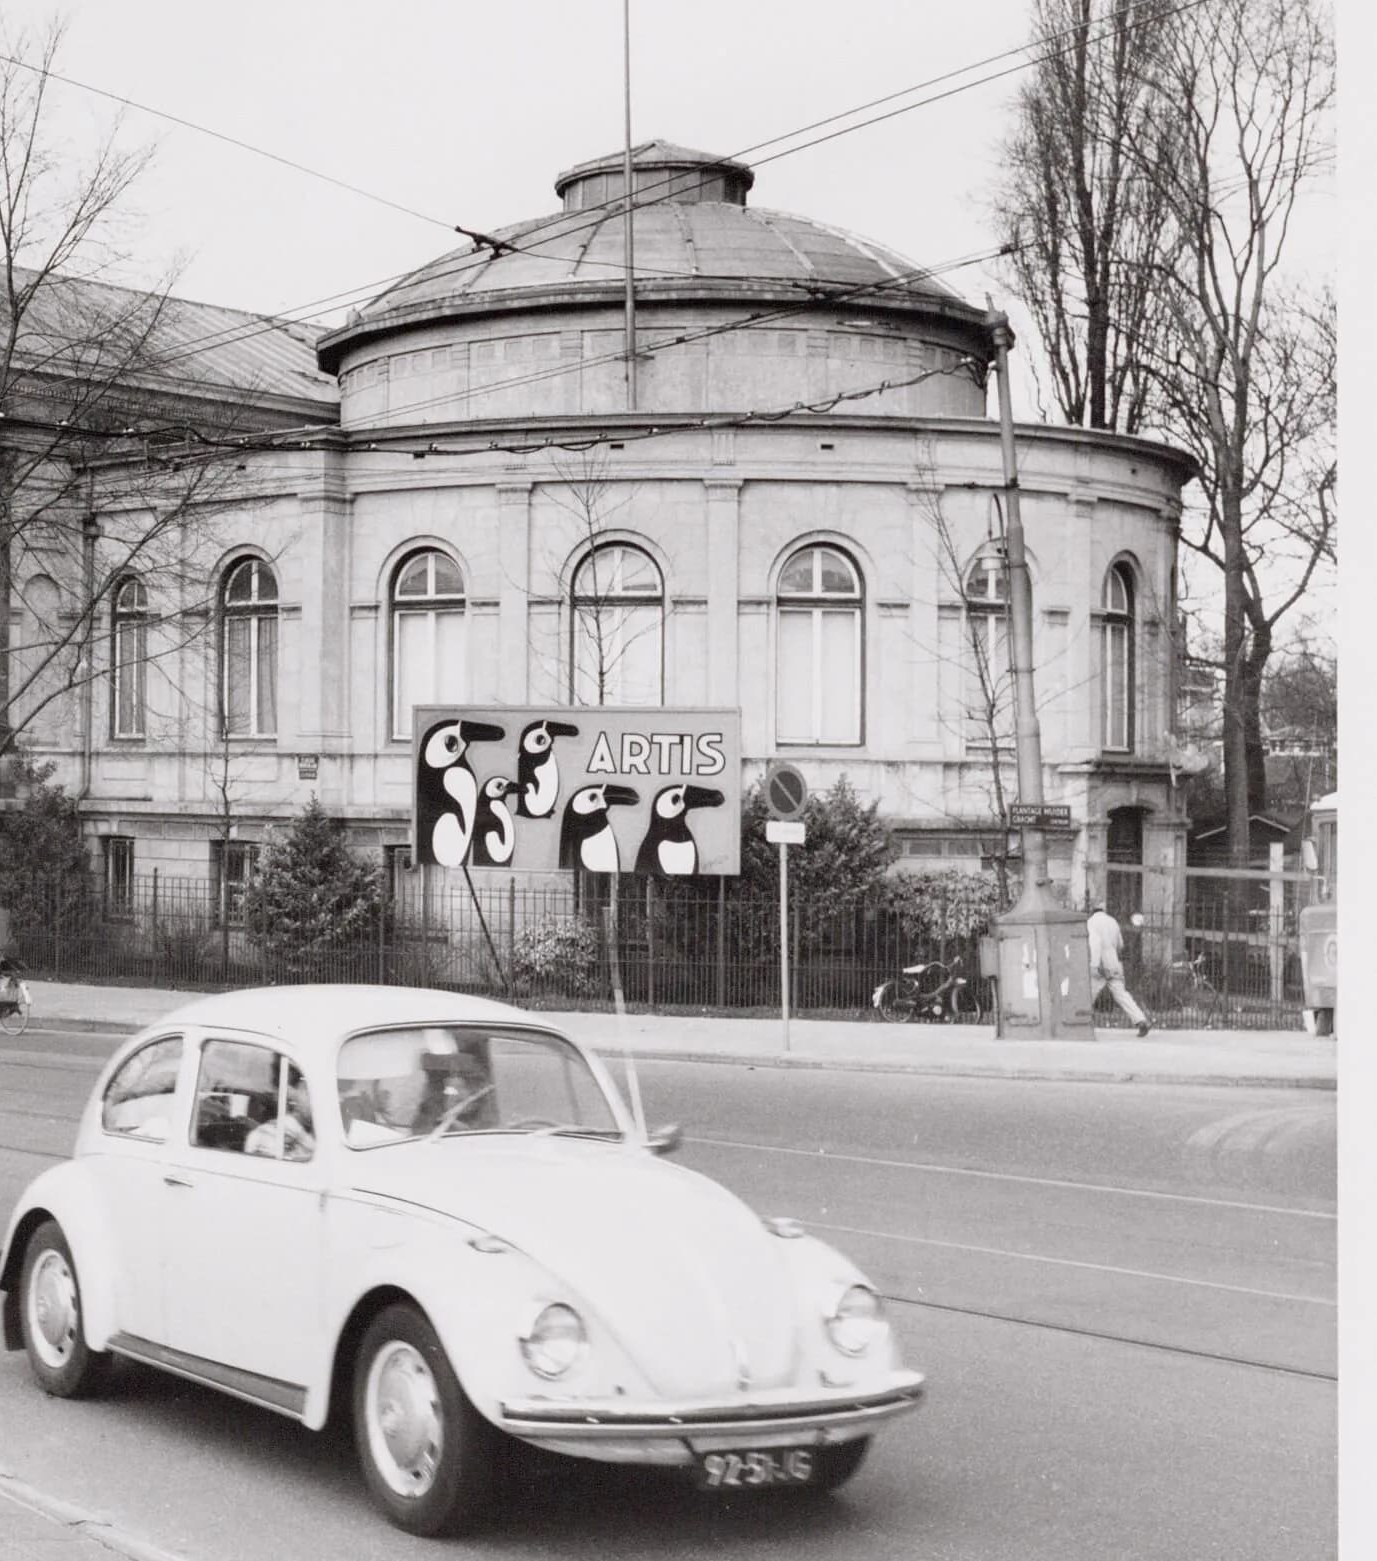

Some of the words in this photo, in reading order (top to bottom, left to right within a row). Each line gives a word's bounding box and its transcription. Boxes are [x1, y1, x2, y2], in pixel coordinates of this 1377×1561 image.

[586, 731, 726, 776] ARTIS
[1011, 807, 1042, 816] PLANTAGE
[1011, 815, 1037, 825] GRACHT
